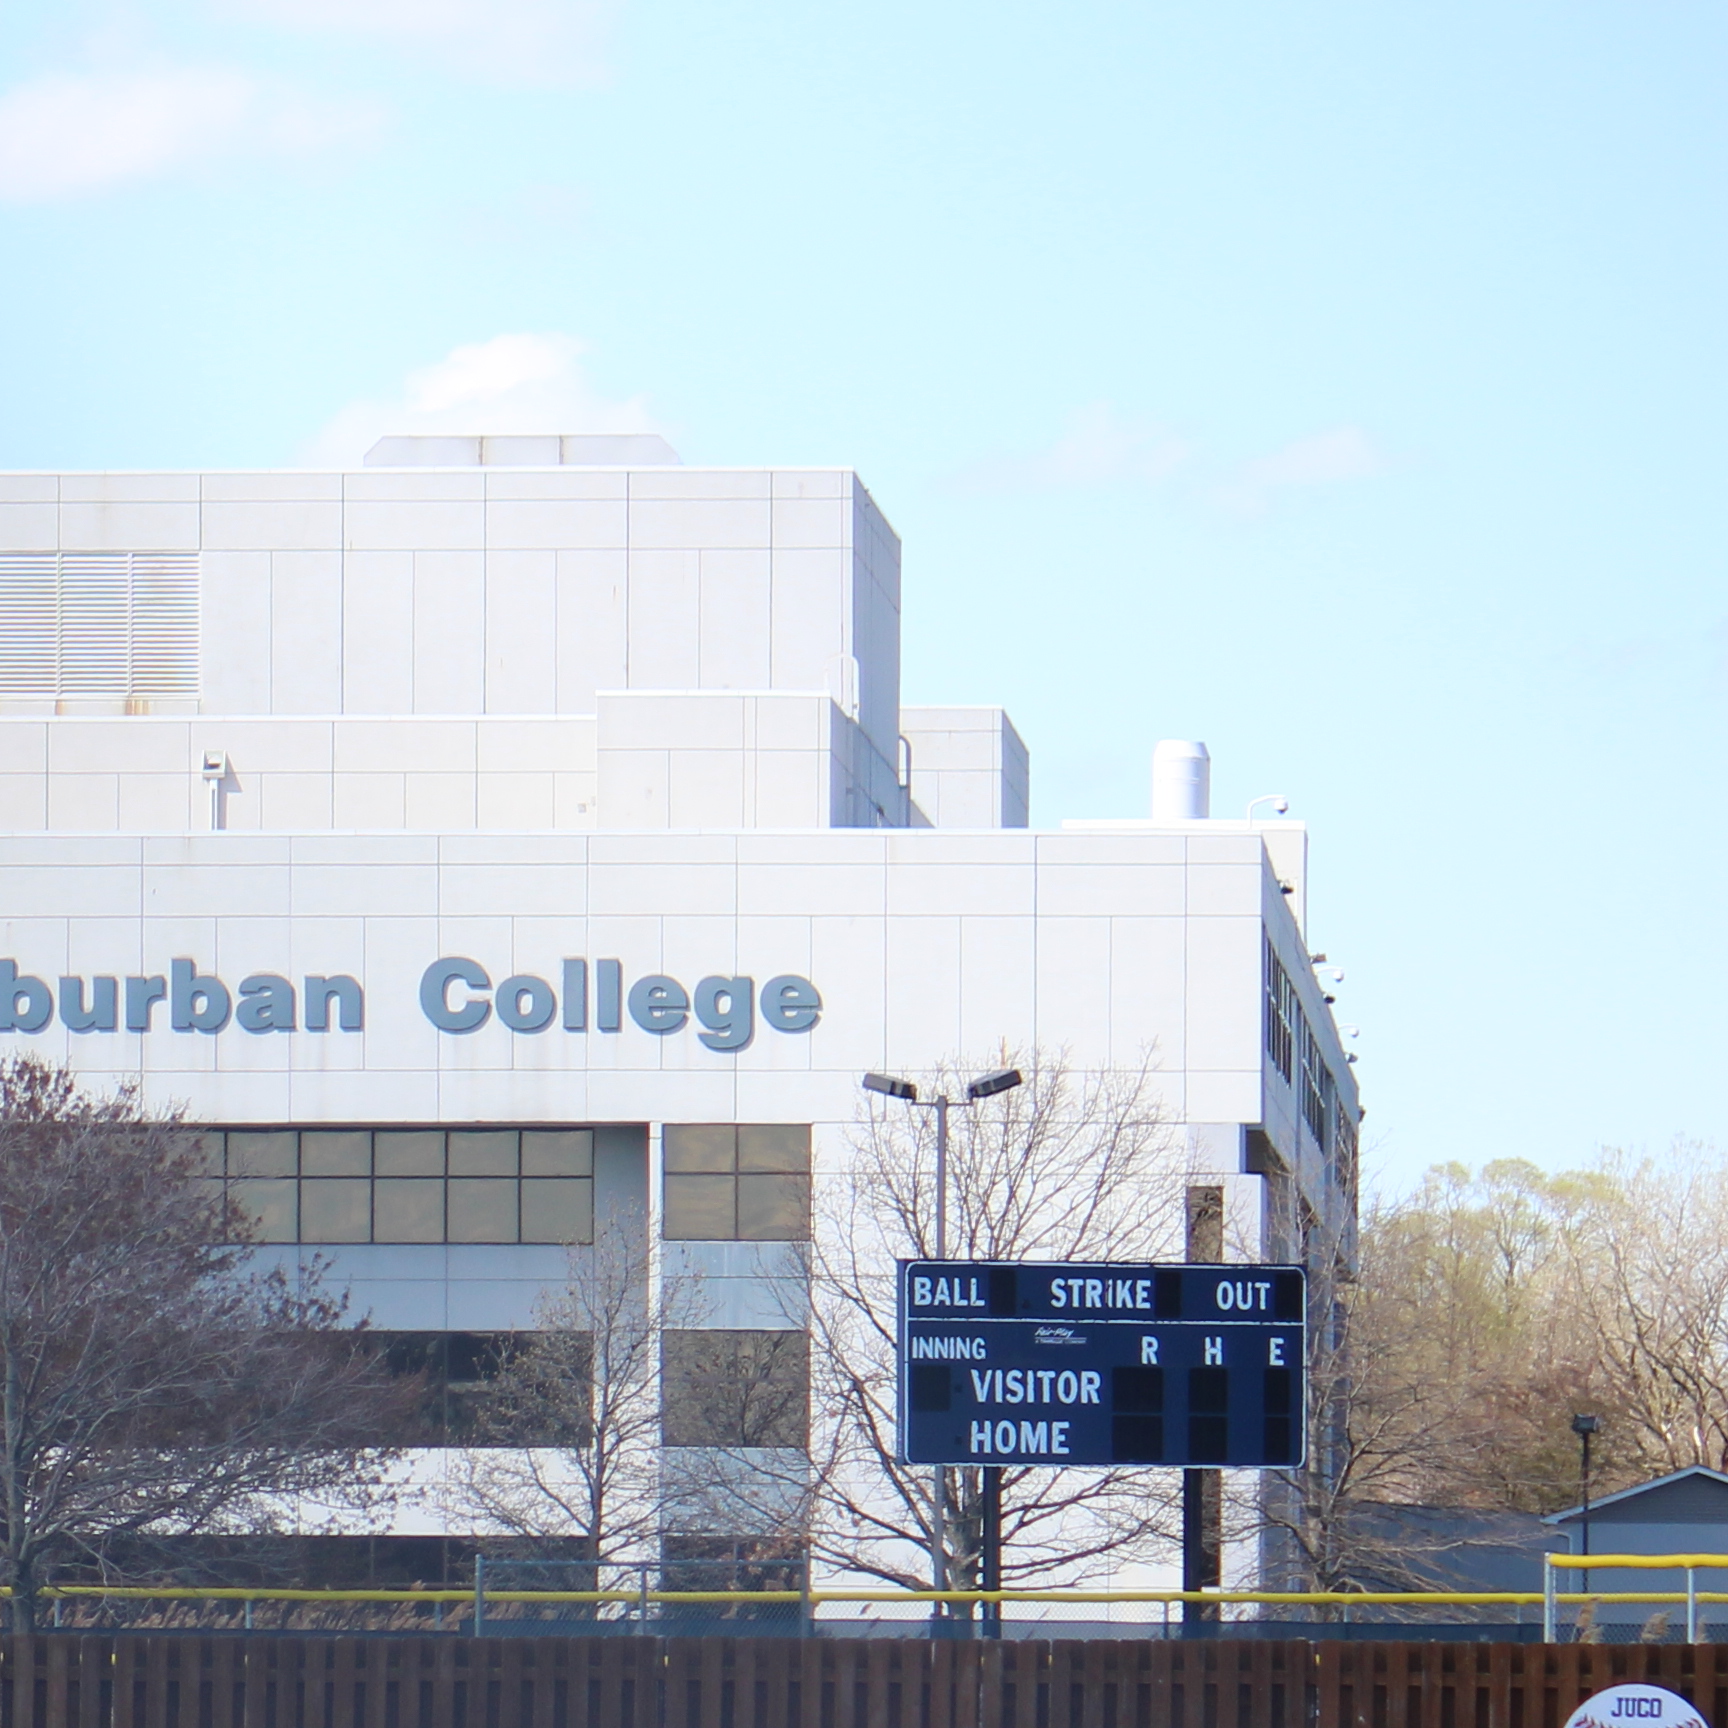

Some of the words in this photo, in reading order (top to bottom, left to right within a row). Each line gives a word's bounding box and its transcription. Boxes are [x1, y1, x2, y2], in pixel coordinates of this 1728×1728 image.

[420, 956, 824, 1053] College
[913, 1277, 986, 1306] BALL
[1050, 1277, 1151, 1309] STRIKE
[1216, 1281, 1271, 1310] OUT
[911, 1336, 987, 1361] INNING
[1141, 1336, 1159, 1365] R
[1204, 1336, 1223, 1365] H
[1269, 1337, 1285, 1366] E
[970, 1369, 1101, 1404] VISITOR
[970, 1420, 1070, 1454] HOME
[1611, 1697, 1663, 1718] JUCO
